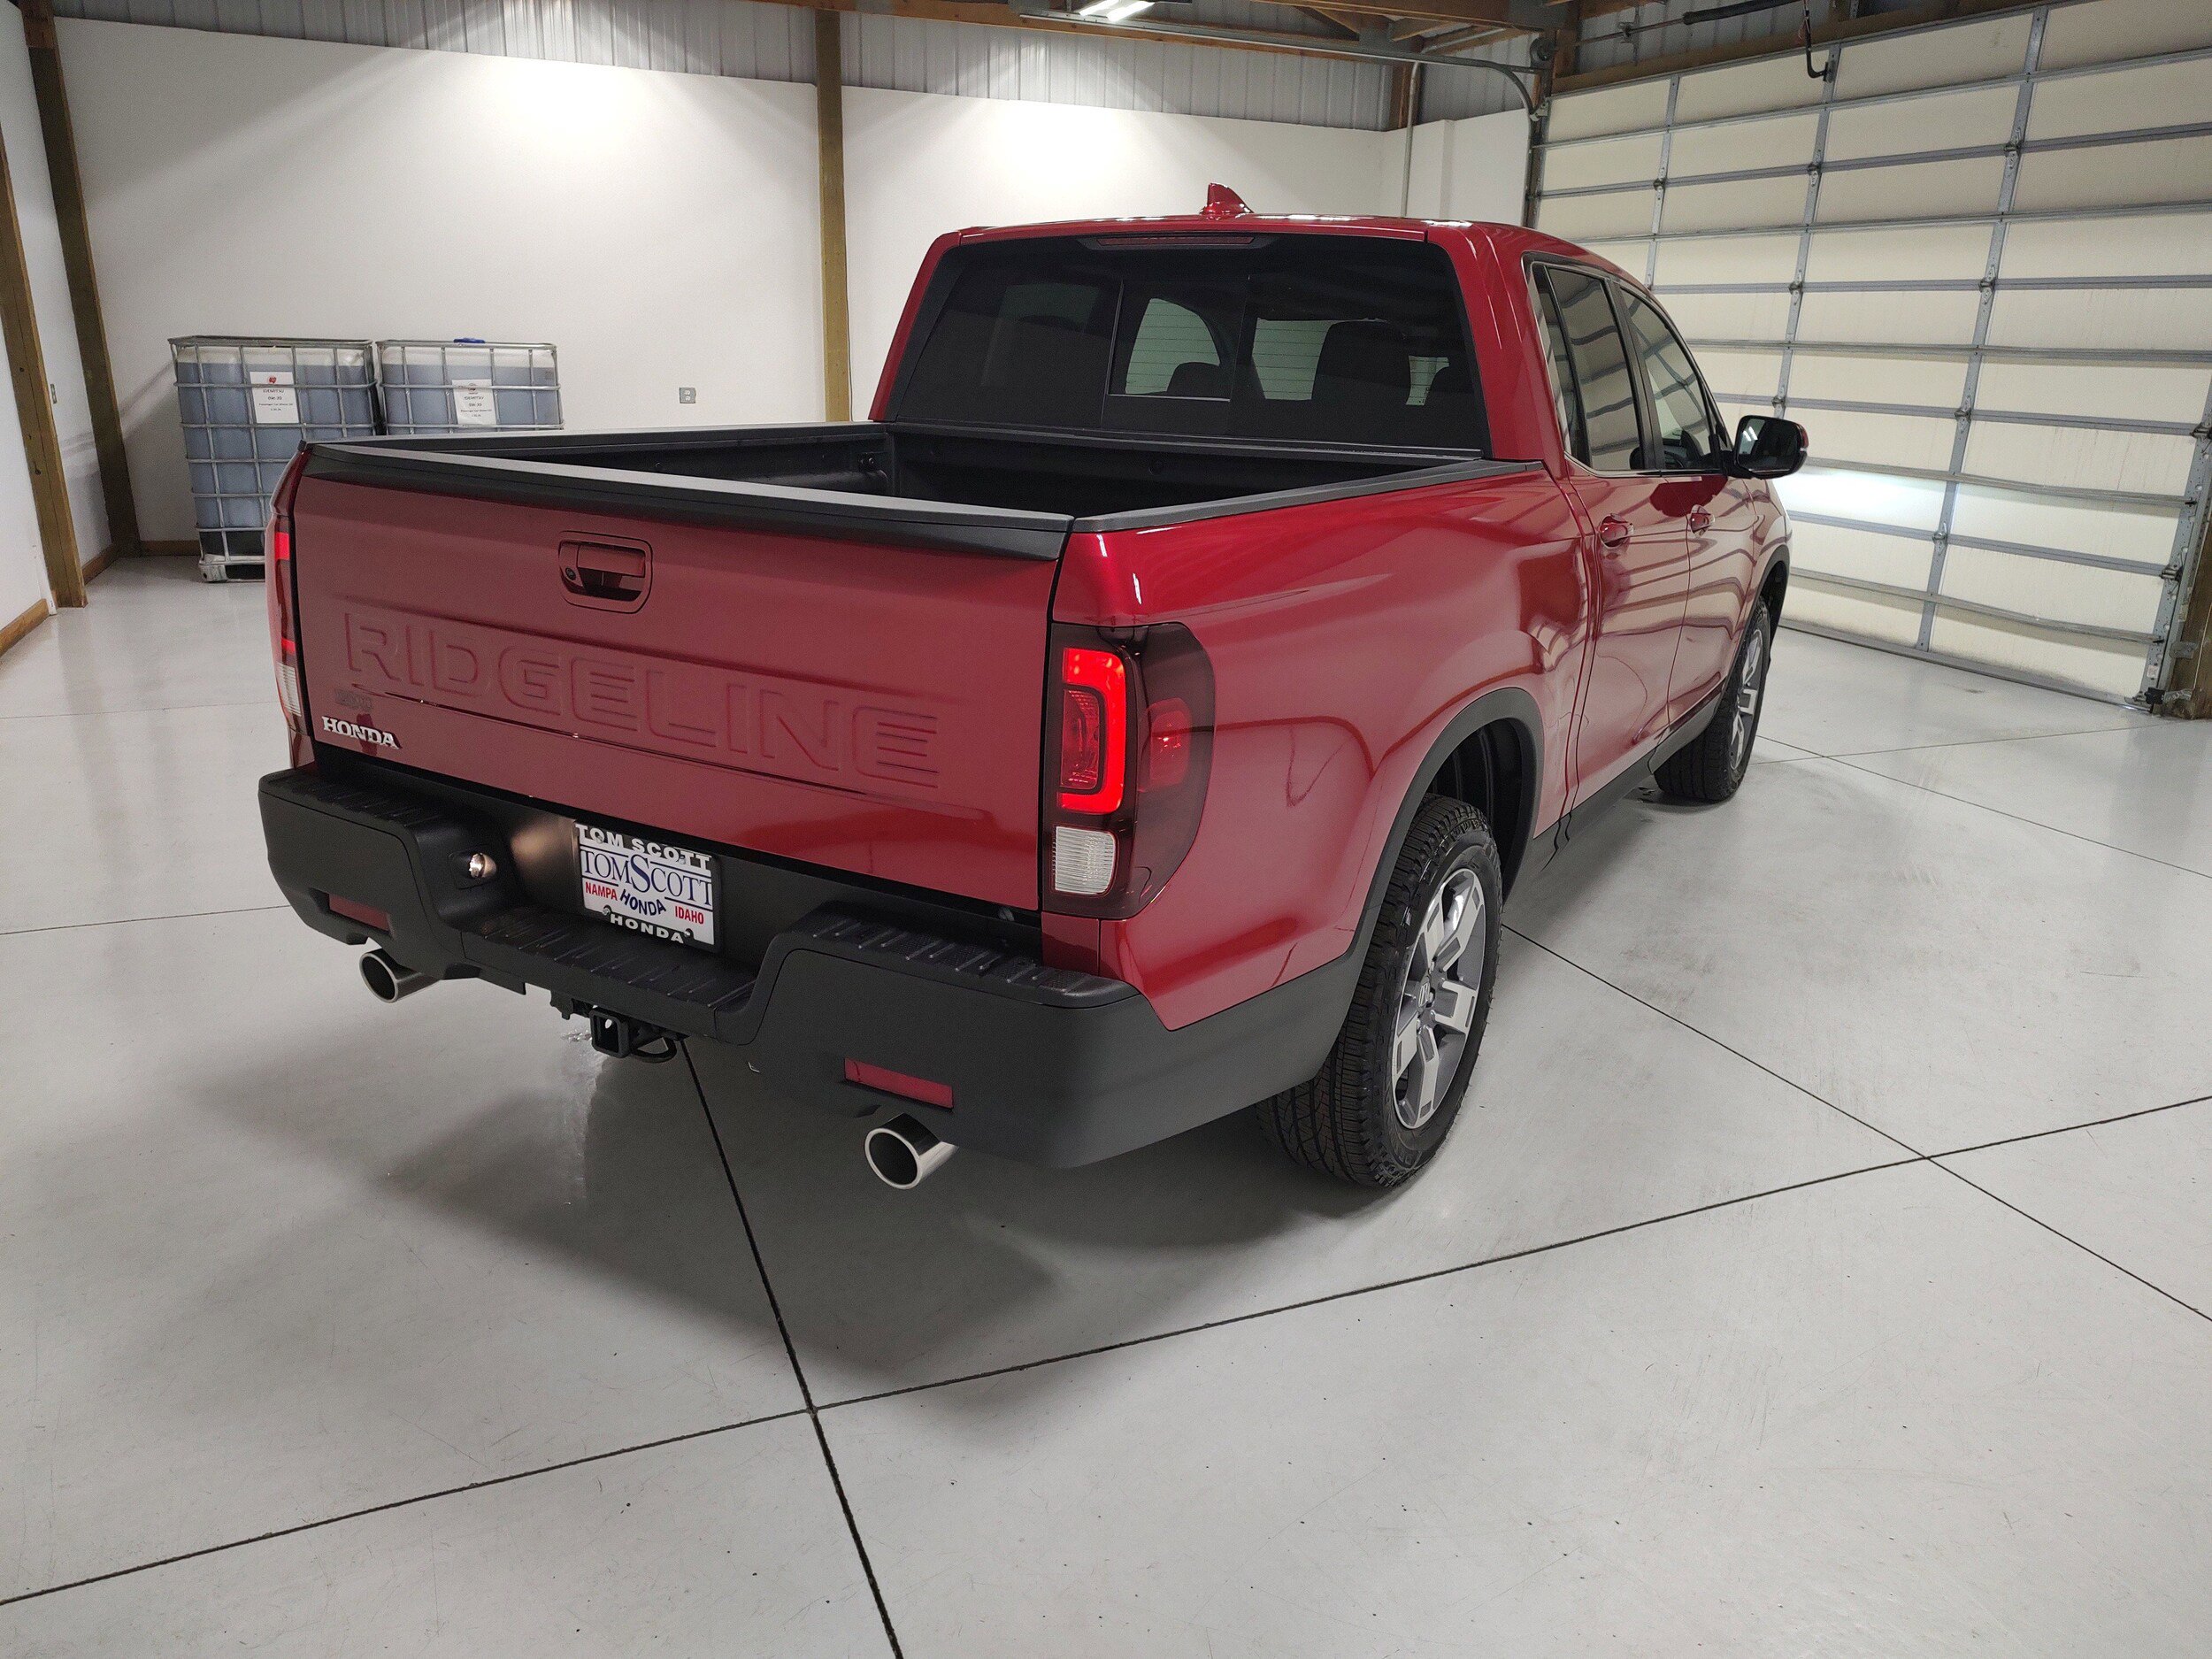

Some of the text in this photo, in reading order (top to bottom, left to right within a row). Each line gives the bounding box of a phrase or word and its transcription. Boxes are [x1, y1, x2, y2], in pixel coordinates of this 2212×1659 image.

[346, 612, 939, 789] RIDGELINE
[321, 716, 400, 750] HONDA
[575, 825, 712, 872] TOM SCOTT
[585, 881, 618, 902] NAMPA
[619, 888, 667, 917] HONDA
[610, 913, 685, 945] HONDA
[674, 905, 705, 926] IDAHO
